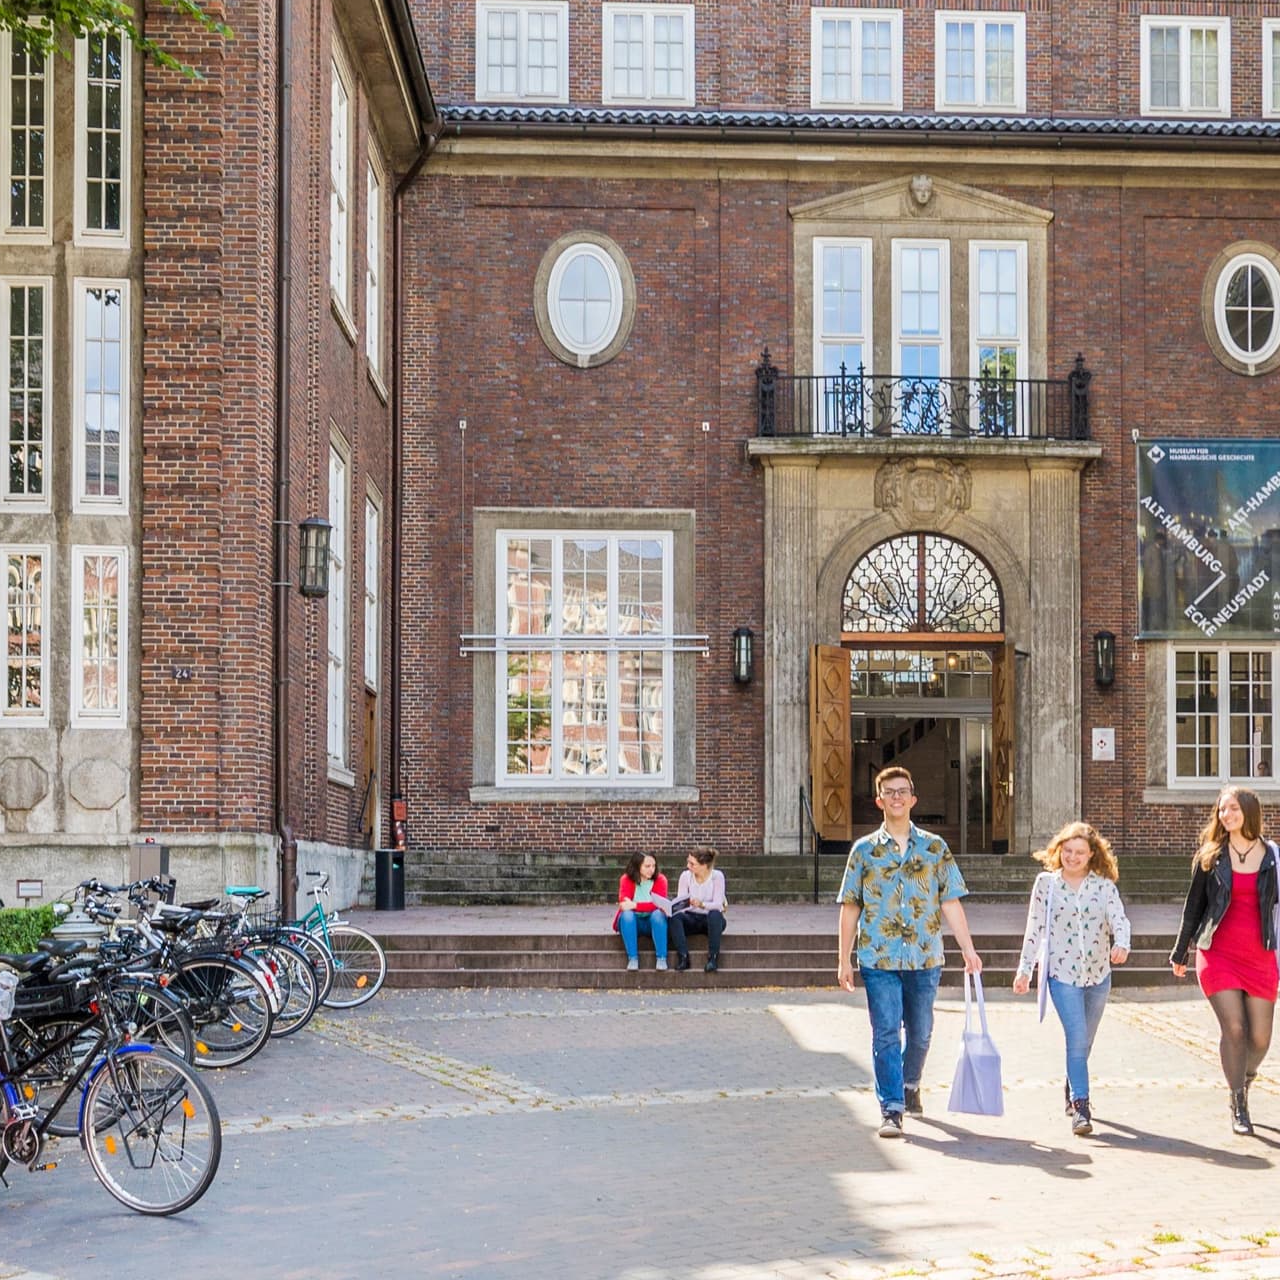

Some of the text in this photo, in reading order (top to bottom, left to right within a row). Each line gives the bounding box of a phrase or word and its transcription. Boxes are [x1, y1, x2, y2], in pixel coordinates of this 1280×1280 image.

[1140, 496, 1223, 572] ALT-HAMBURG
[1184, 605, 1217, 637] ECKE
[1212, 570, 1270, 628] NEUSTADT
[175, 668, 188, 678] 24
